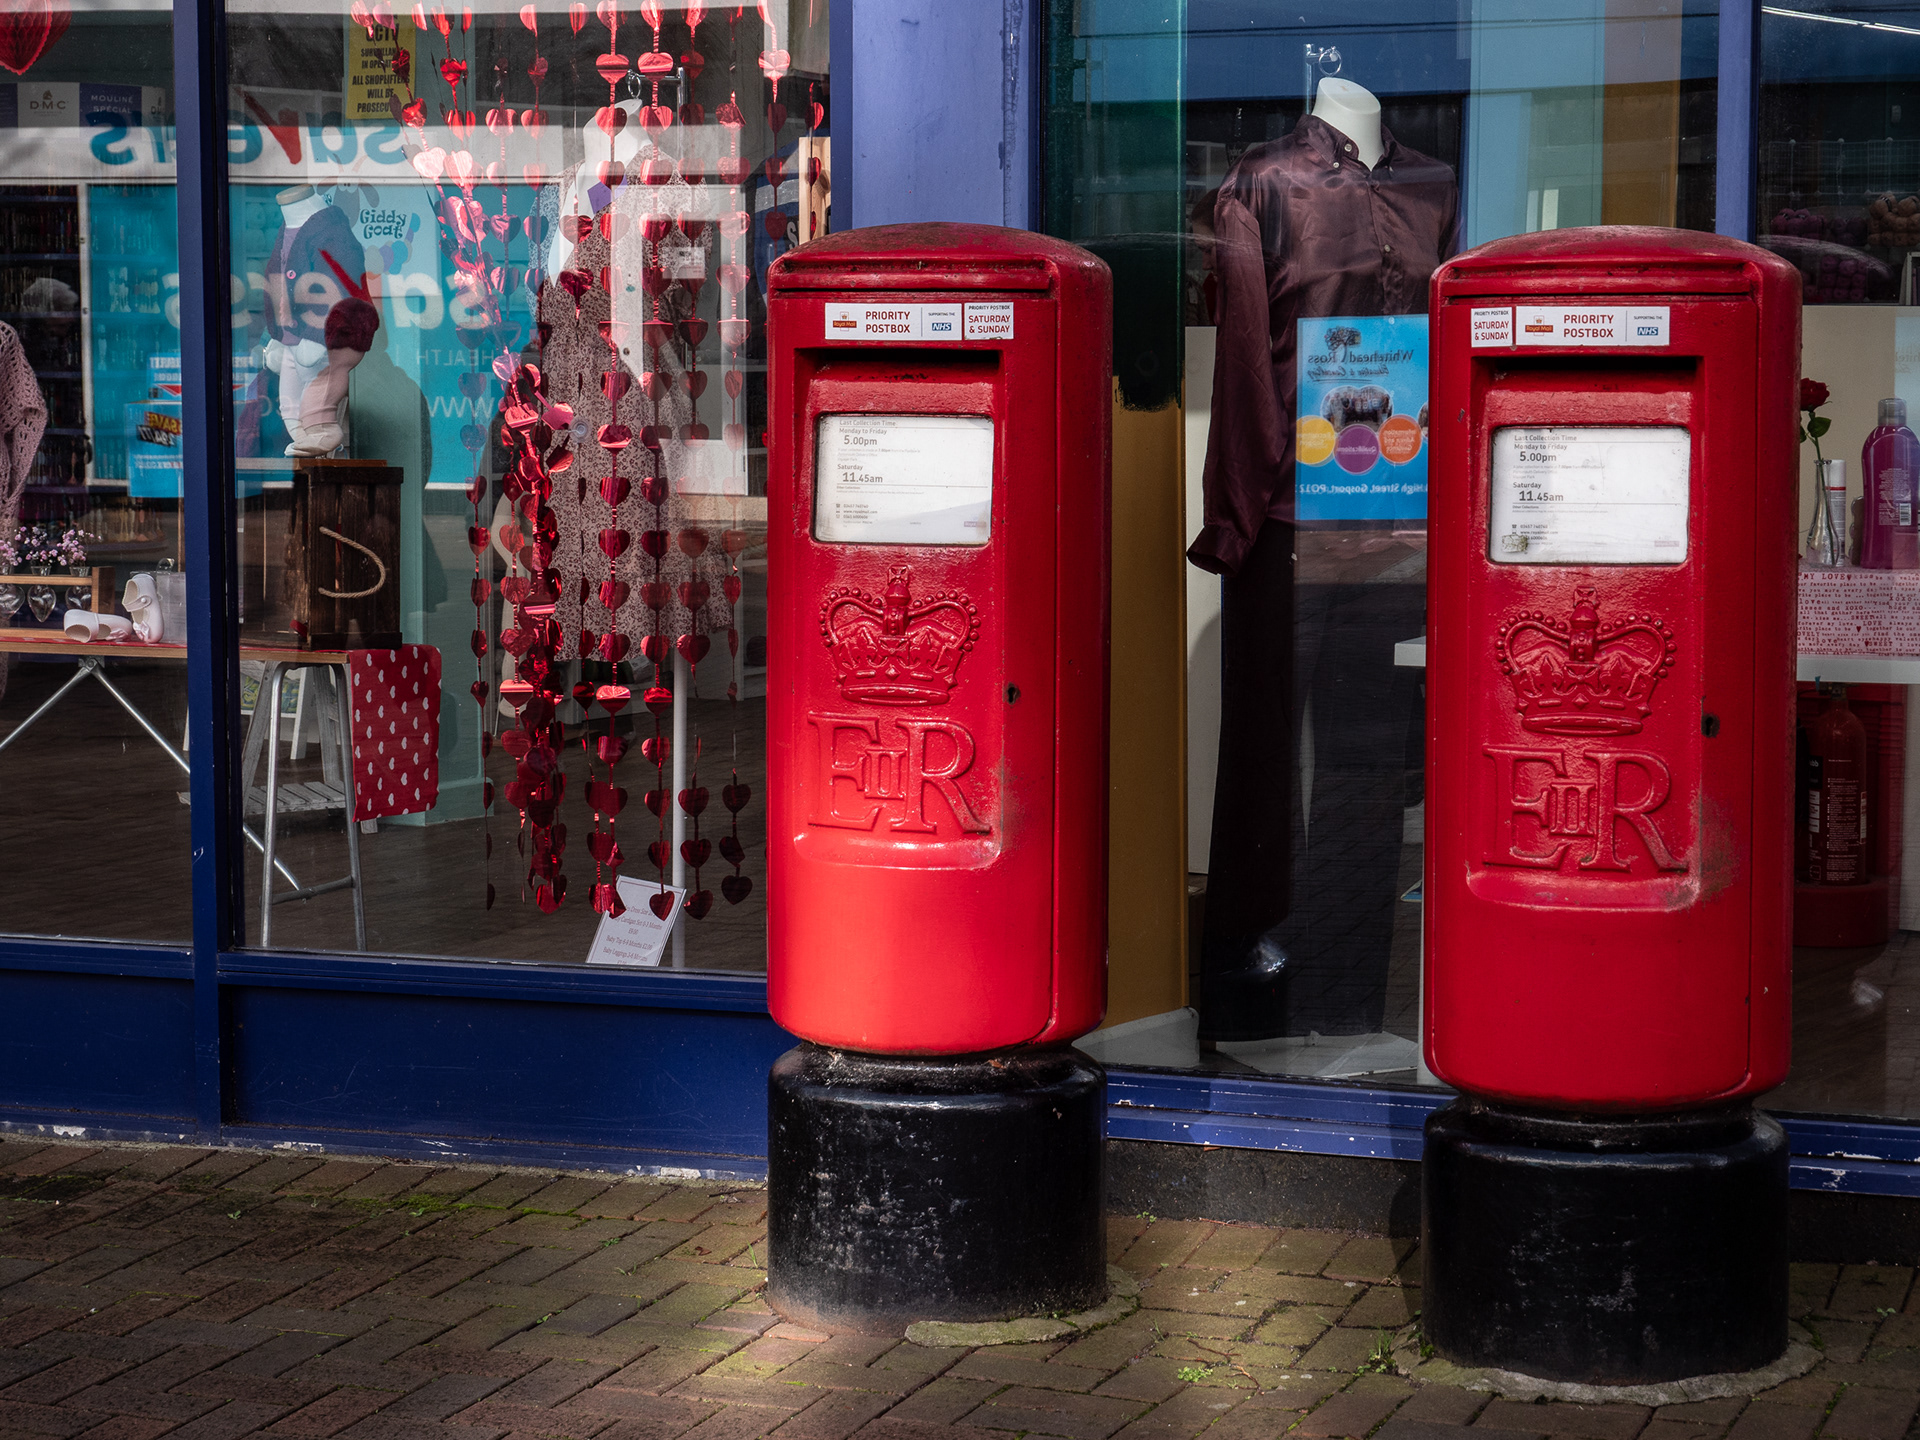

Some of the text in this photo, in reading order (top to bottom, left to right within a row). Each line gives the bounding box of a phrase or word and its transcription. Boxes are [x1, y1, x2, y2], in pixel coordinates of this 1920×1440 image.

[362, 60, 368, 68] IN
[352, 75, 364, 85] ALL
[367, 88, 394, 98] WILL BE
[360, 209, 407, 227] Giddy
[364, 224, 403, 239] Goat
[865, 311, 911, 320] PRIORITY
[968, 315, 1011, 323] SATURDAY
[1564, 315, 1614, 324] PRIORITY
[865, 324, 911, 333] POSTBOX
[1474, 321, 1509, 330] SATURDAY
[1564, 329, 1614, 338] POSTBOX
[1638, 327, 1658, 335] NHS
[1482, 332, 1509, 340] SUNDAY
[844, 435, 877, 446] 5.00pm
[1519, 451, 1556, 462] 5.00pm
[842, 472, 883, 483] 11.45am
[1519, 491, 1564, 501] 11.45am
